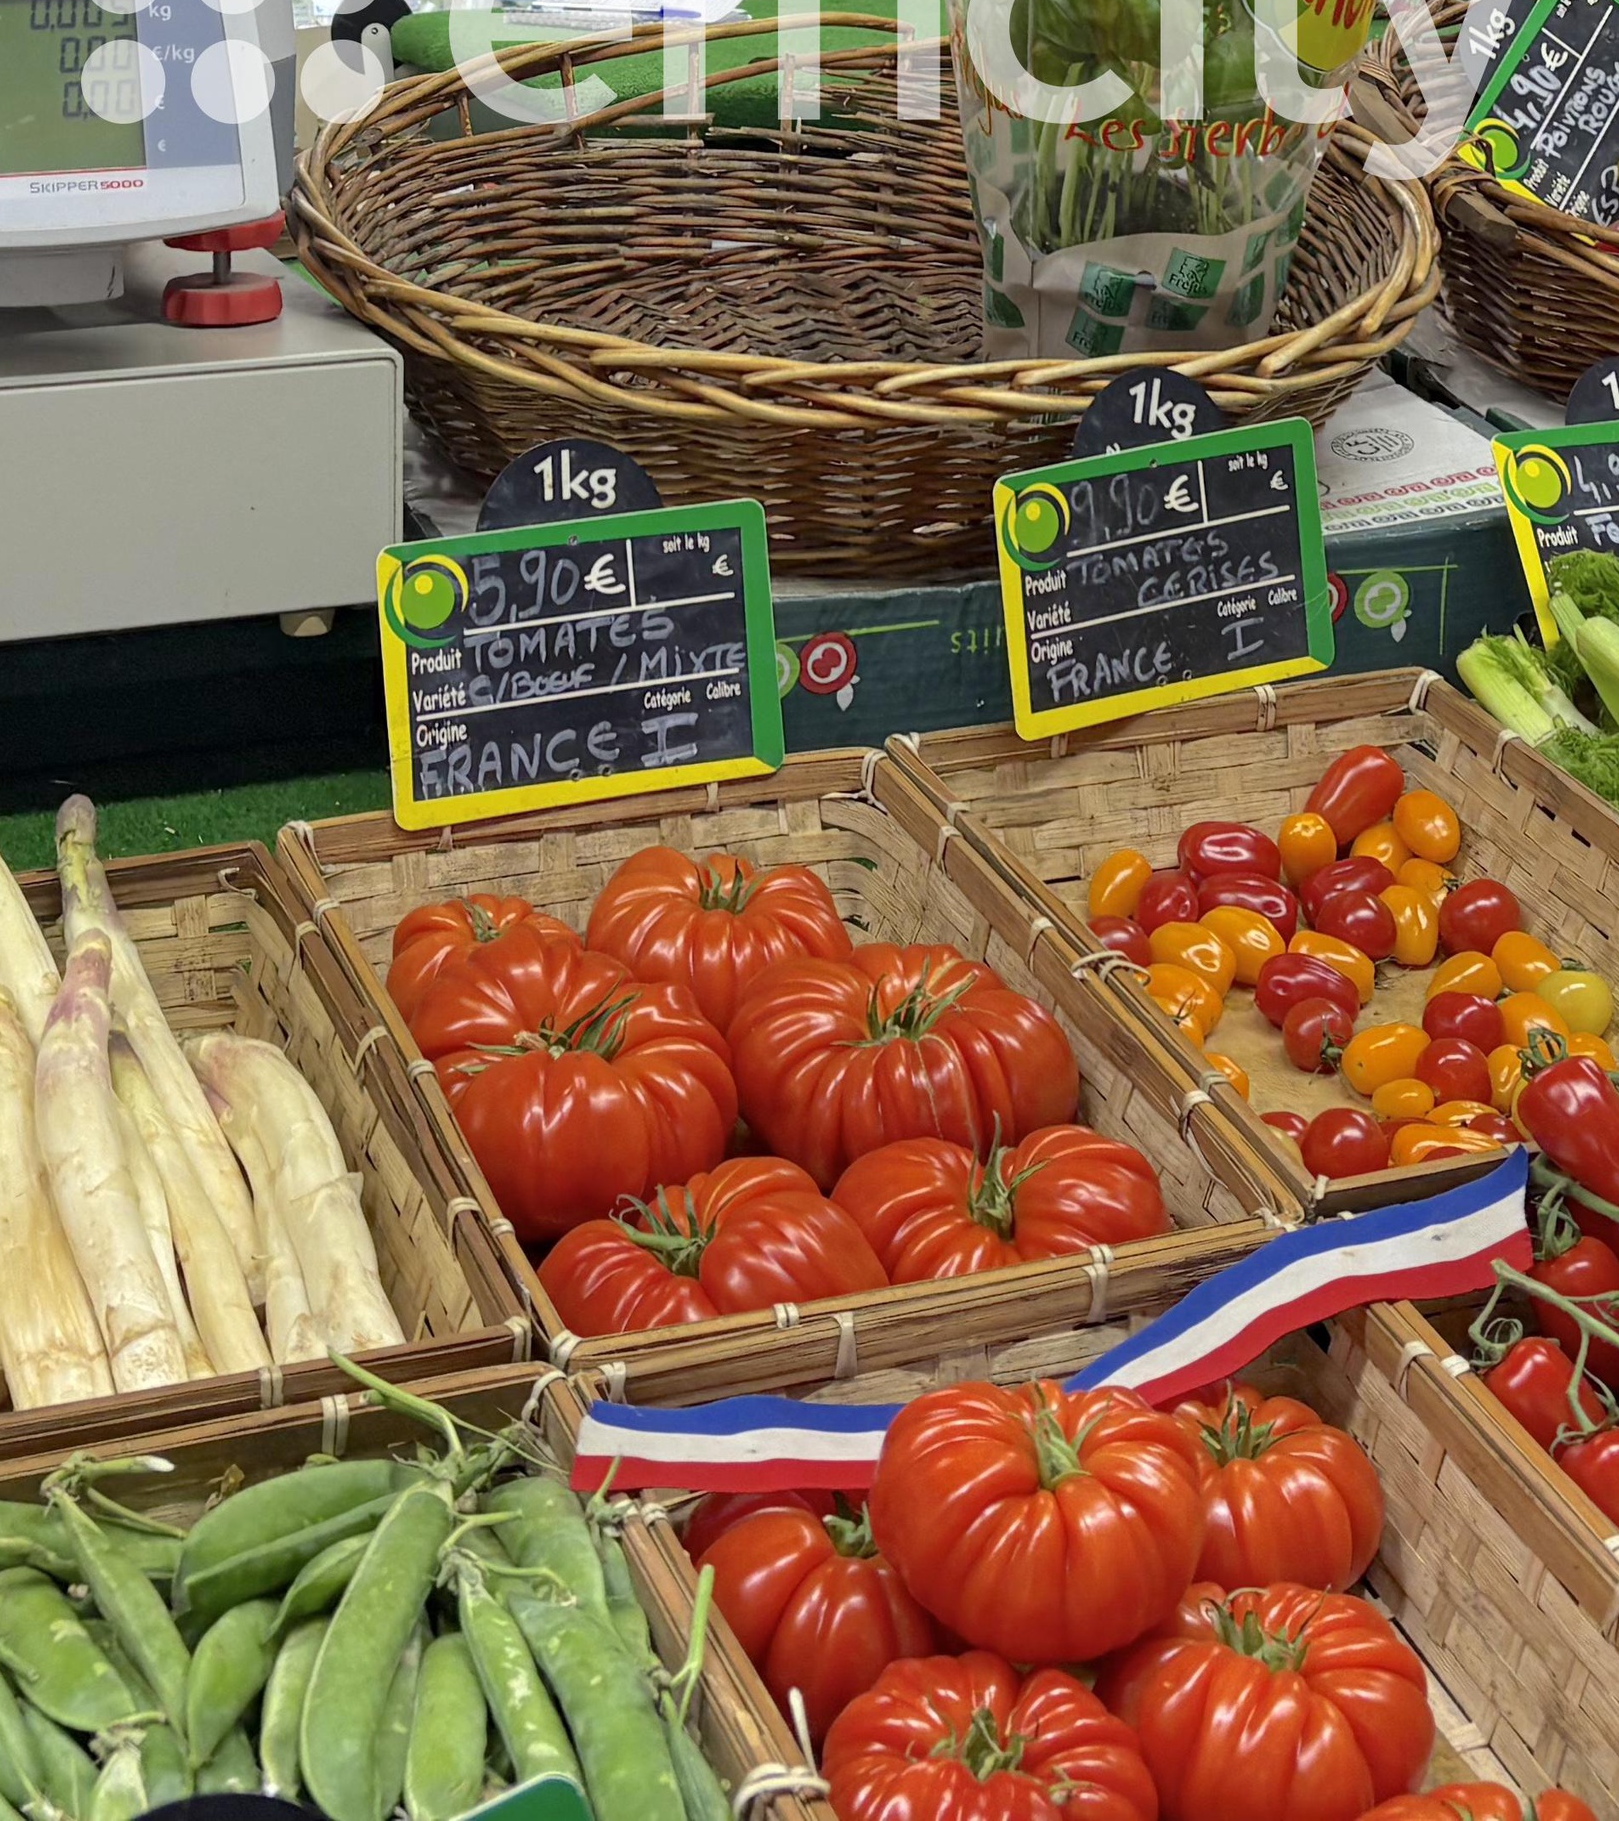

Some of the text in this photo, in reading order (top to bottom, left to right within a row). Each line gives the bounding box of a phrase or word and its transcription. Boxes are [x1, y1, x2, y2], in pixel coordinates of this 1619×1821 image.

[147, 2, 172, 21] kg
[1468, 7, 1516, 60] 1kg
[151, 43, 196, 64] €/kg
[1540, 41, 1569, 72] €
[1128, 377, 1197, 441] 1kg
[533, 448, 618, 510] 1kg
[1537, 526, 1579, 548] Produit
[1066, 531, 1230, 586] TOMATES
[469, 548, 581, 628] 5,90
[1024, 569, 1068, 597] Produit
[1137, 550, 1279, 608] CERISES
[1027, 603, 1072, 631] Variété
[1216, 588, 1298, 619] Catégorie Calibre
[463, 605, 676, 672] TOMATES
[1030, 637, 1074, 666] Origine
[411, 649, 463, 675] Produit
[638, 641, 747, 680] MIXTE
[1046, 641, 1173, 703] FRANCE
[412, 684, 467, 712] Variété
[643, 680, 742, 710] Catégorie Calibre
[416, 720, 469, 750] Origine
[419, 720, 621, 795] FRANCE
